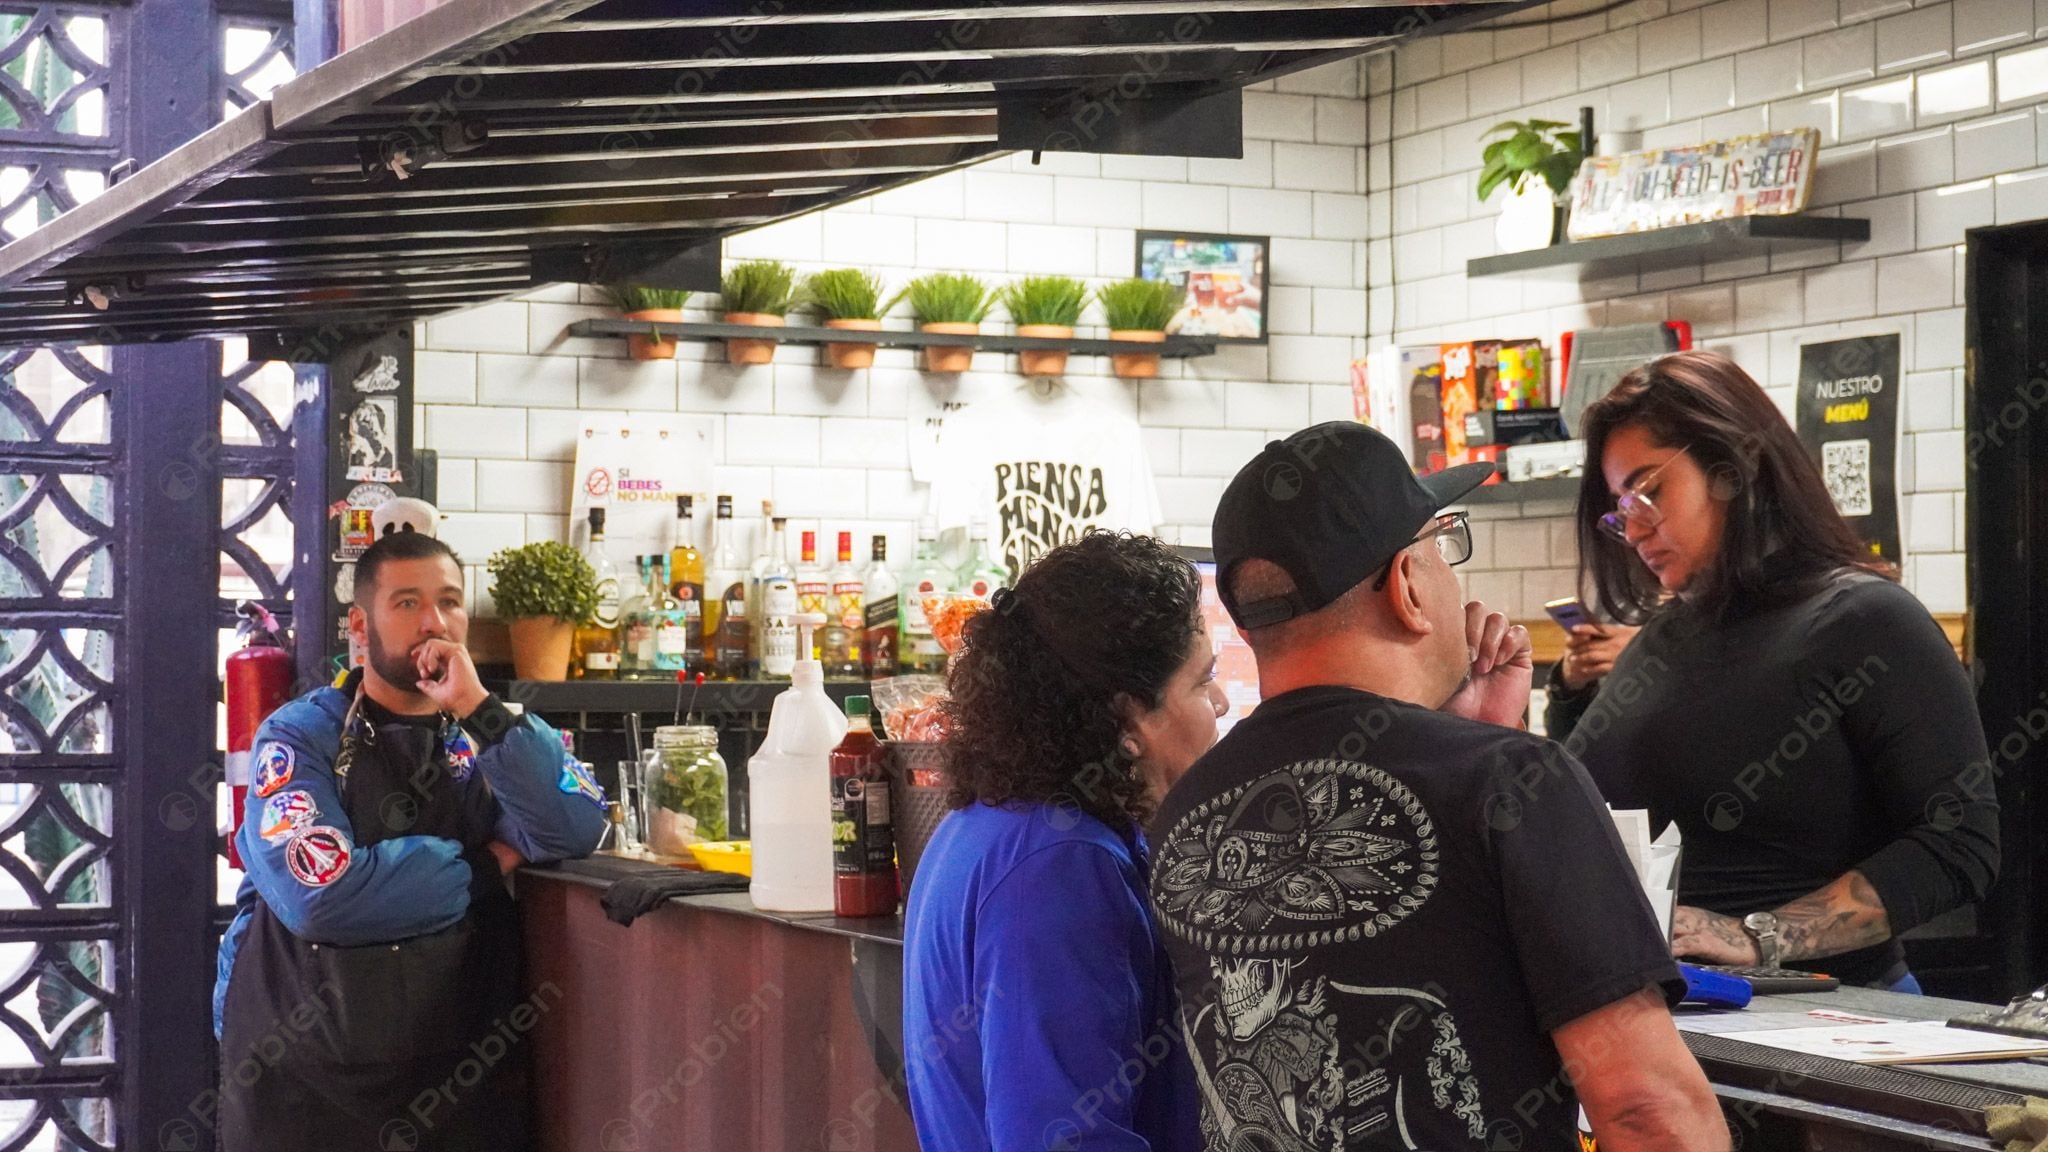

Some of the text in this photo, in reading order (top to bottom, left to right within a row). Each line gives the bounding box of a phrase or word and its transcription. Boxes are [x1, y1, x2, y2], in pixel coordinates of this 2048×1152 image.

[1816, 374, 1883, 399] NUESTRO
[1824, 397, 1869, 423] MENÚ
[618, 468, 630, 478] SI
[618, 480, 662, 490] BEBES
[617, 491, 638, 502] NO
[995, 461, 1107, 519] PIENSA
[999, 496, 1097, 546] MENO
